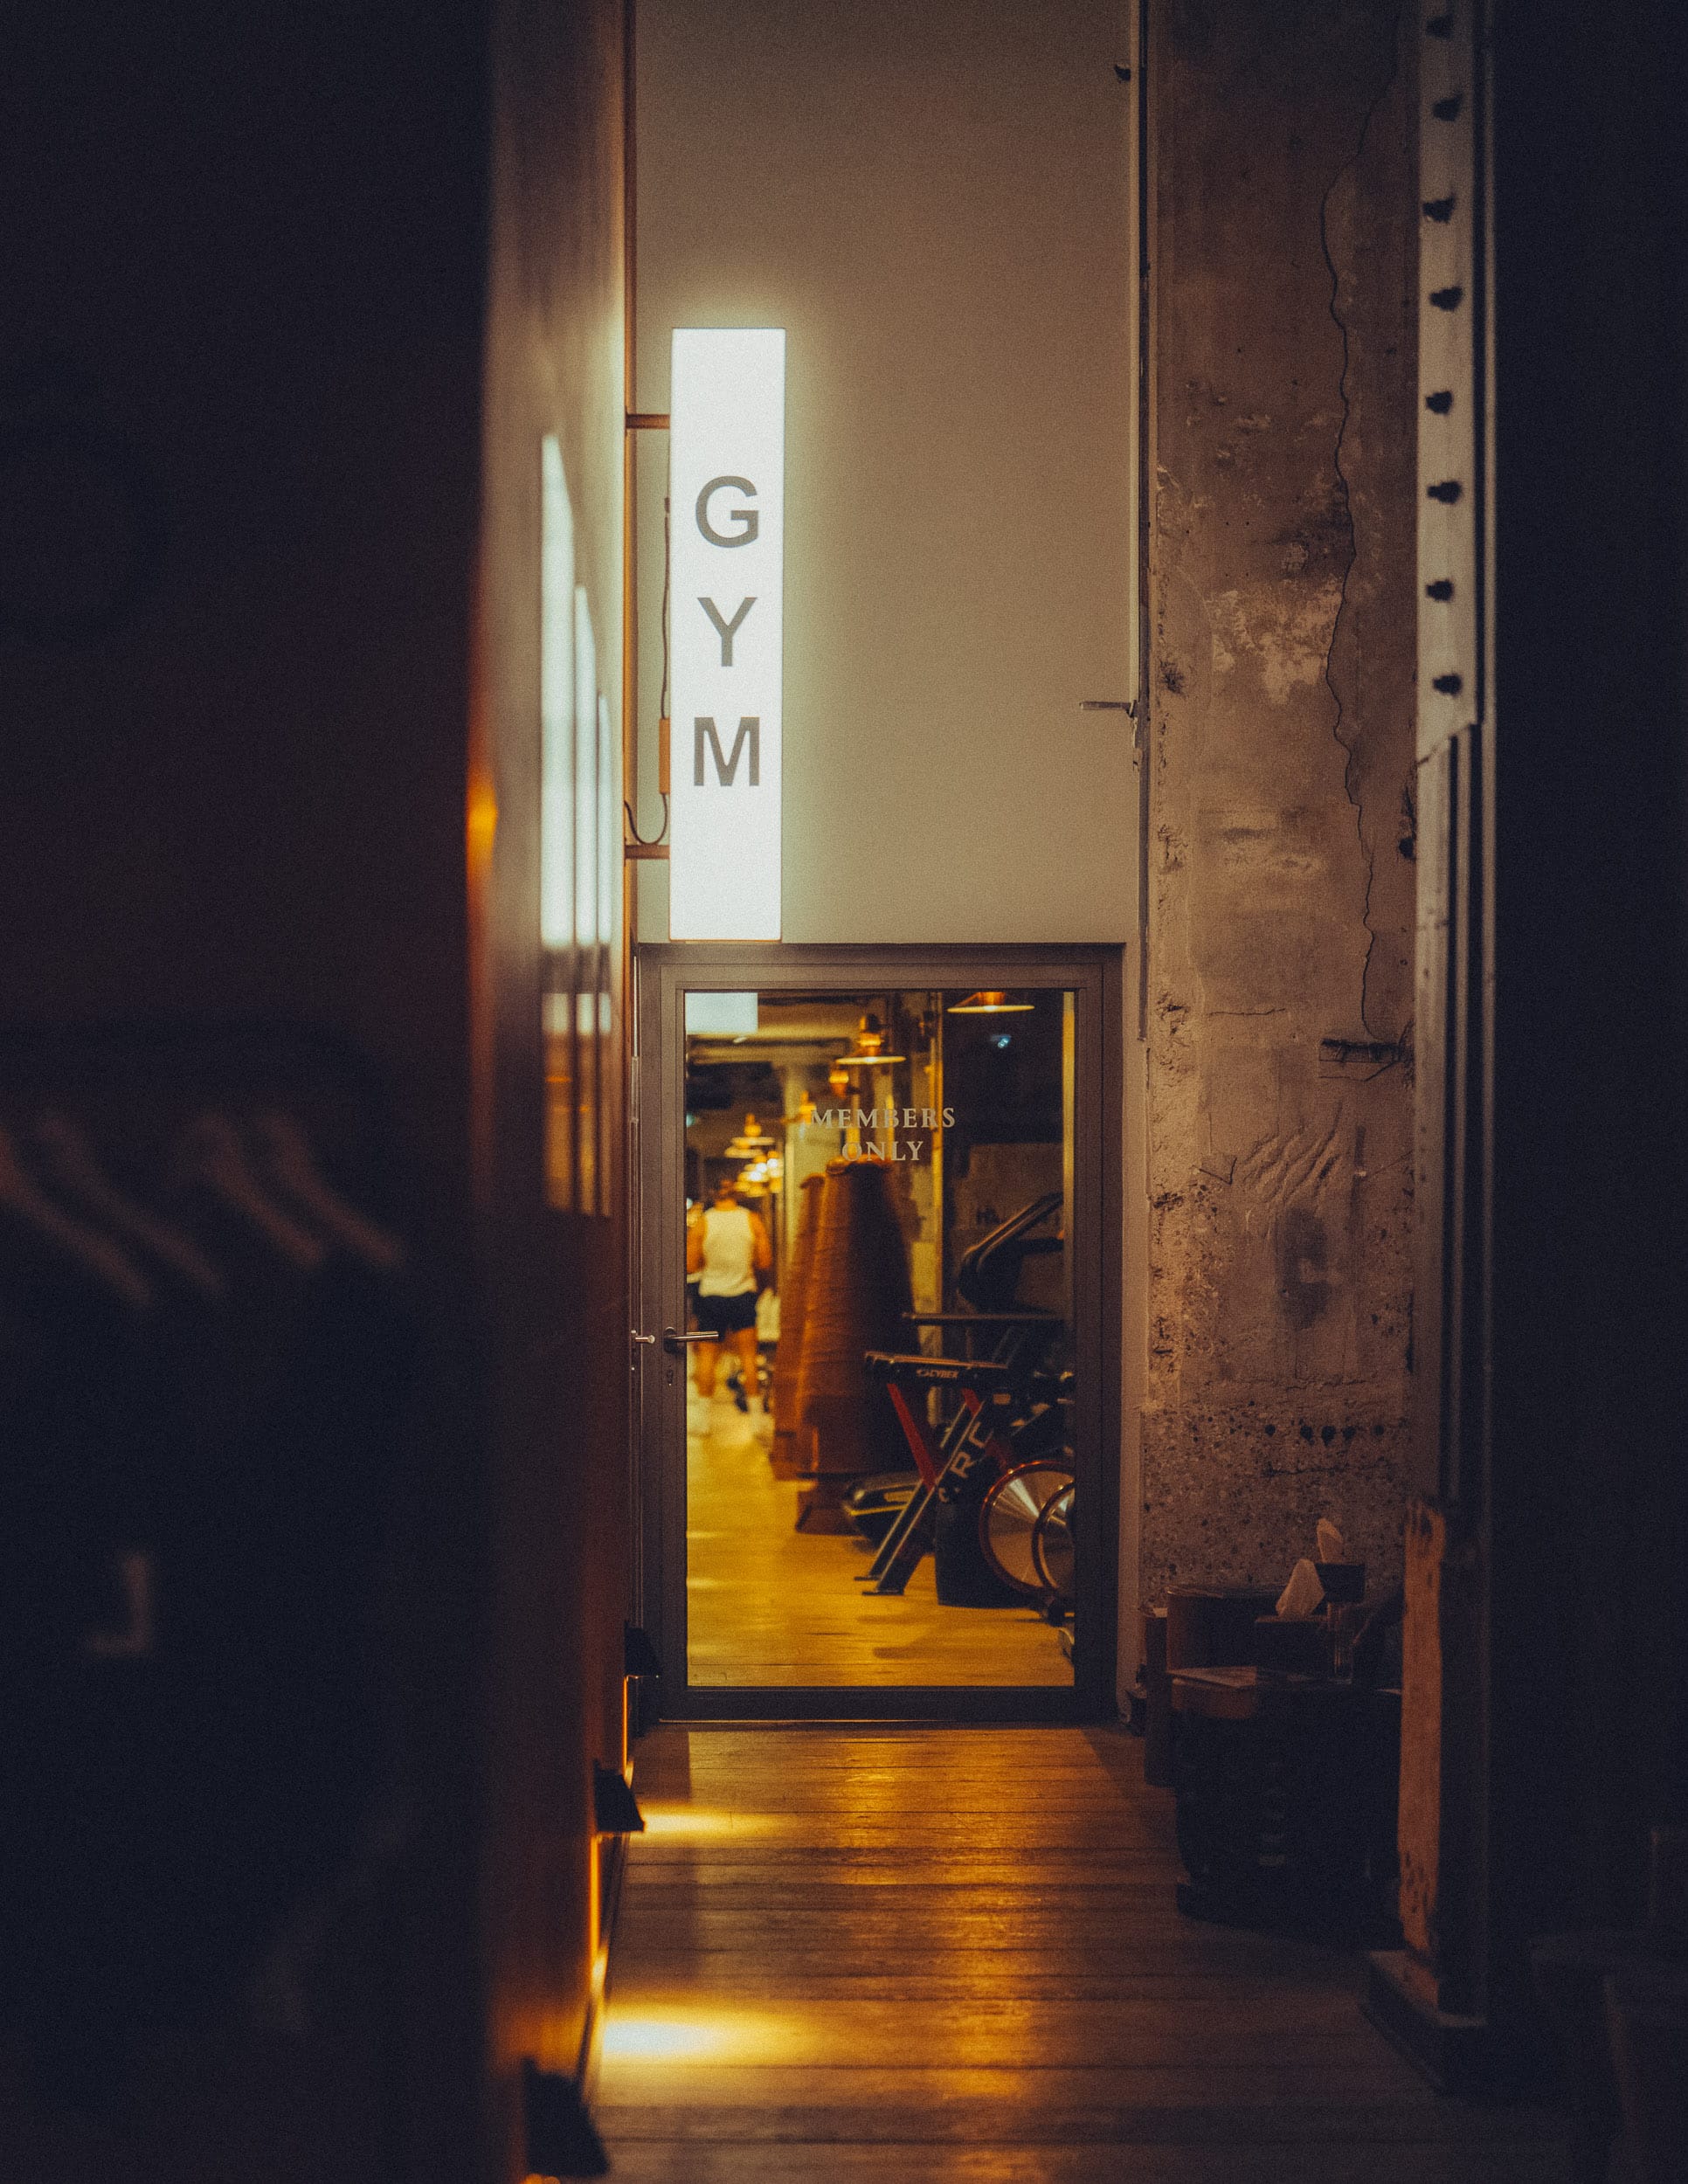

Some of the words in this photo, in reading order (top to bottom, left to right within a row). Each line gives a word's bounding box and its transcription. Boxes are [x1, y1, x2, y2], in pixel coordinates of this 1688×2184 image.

[694, 474, 760, 787] GYM
[811, 1107, 956, 1129] MEMBERS
[841, 1140, 924, 1162] ONLY
